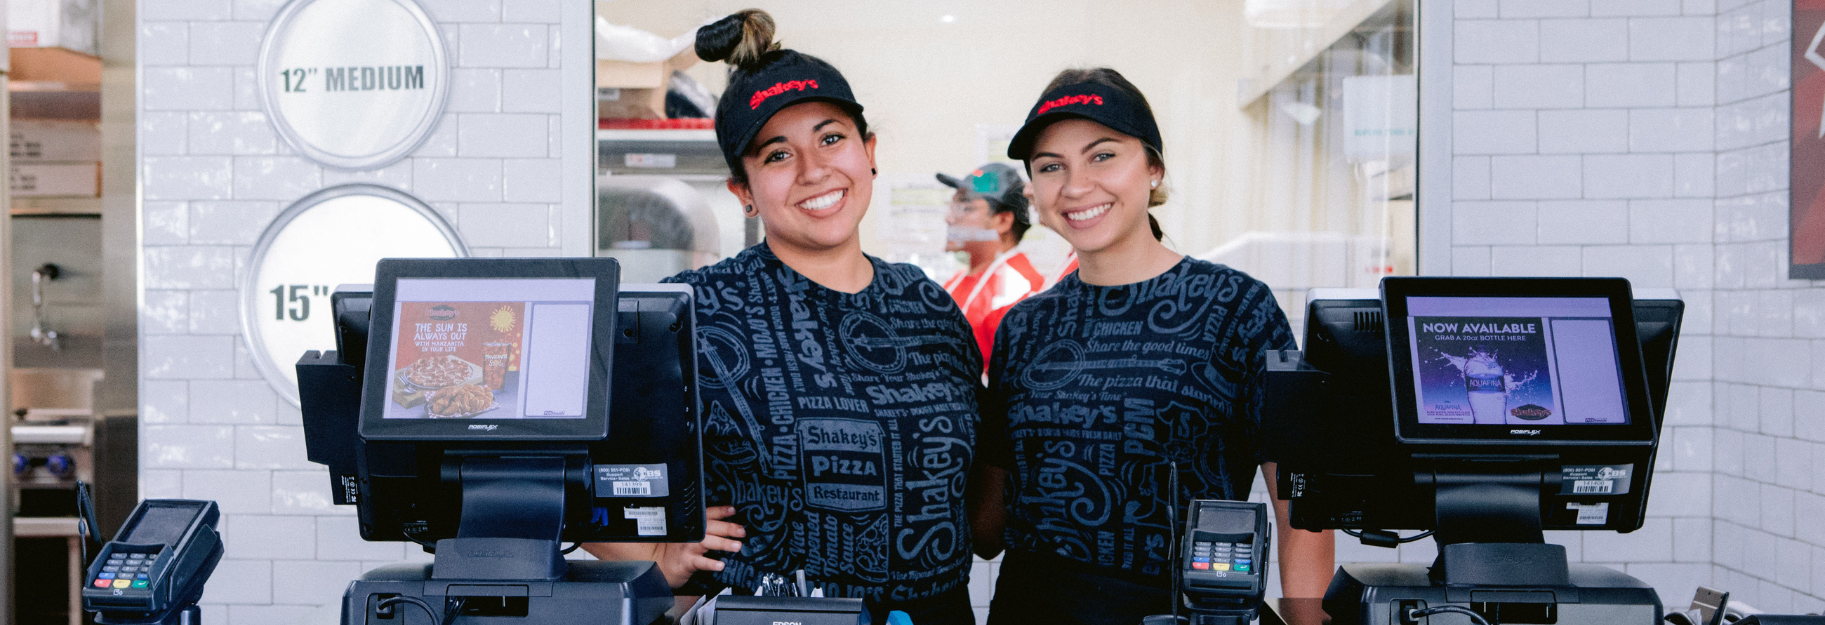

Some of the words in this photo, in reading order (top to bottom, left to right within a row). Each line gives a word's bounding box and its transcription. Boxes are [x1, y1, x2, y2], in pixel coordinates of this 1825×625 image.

[281, 68, 317, 92] 12"
[325, 65, 424, 92] MEDIUM
[750, 79, 819, 110] Shakey's
[1037, 94, 1104, 115] Shakey's
[270, 285, 329, 321] 15"
[414, 332, 448, 341] ALWAYS
[450, 332, 467, 341] OUT
[415, 323, 432, 333] THE
[435, 323, 454, 333] SUN
[457, 323, 468, 333] IS
[1423, 323, 1458, 333] NOW
[1462, 323, 1537, 334] AVAILABLE
[1085, 340, 1121, 354] Share
[1121, 340, 1142, 352] the
[1141, 339, 1176, 355] good
[1174, 343, 1210, 360] times
[1077, 373, 1103, 388] The
[1101, 374, 1144, 392] pizza
[1144, 375, 1179, 393] that
[797, 396, 833, 410] PIZZA
[833, 397, 870, 413] LOVER
[1007, 401, 1118, 430] Shakey's
[806, 426, 878, 450] Shakey's
[814, 485, 881, 502] Restaurant
[896, 415, 973, 561] Shakey's
[789, 520, 806, 557] Vine
[804, 510, 821, 577] Ripened
[822, 514, 840, 578] Tomato
[839, 522, 856, 576] Sauce
